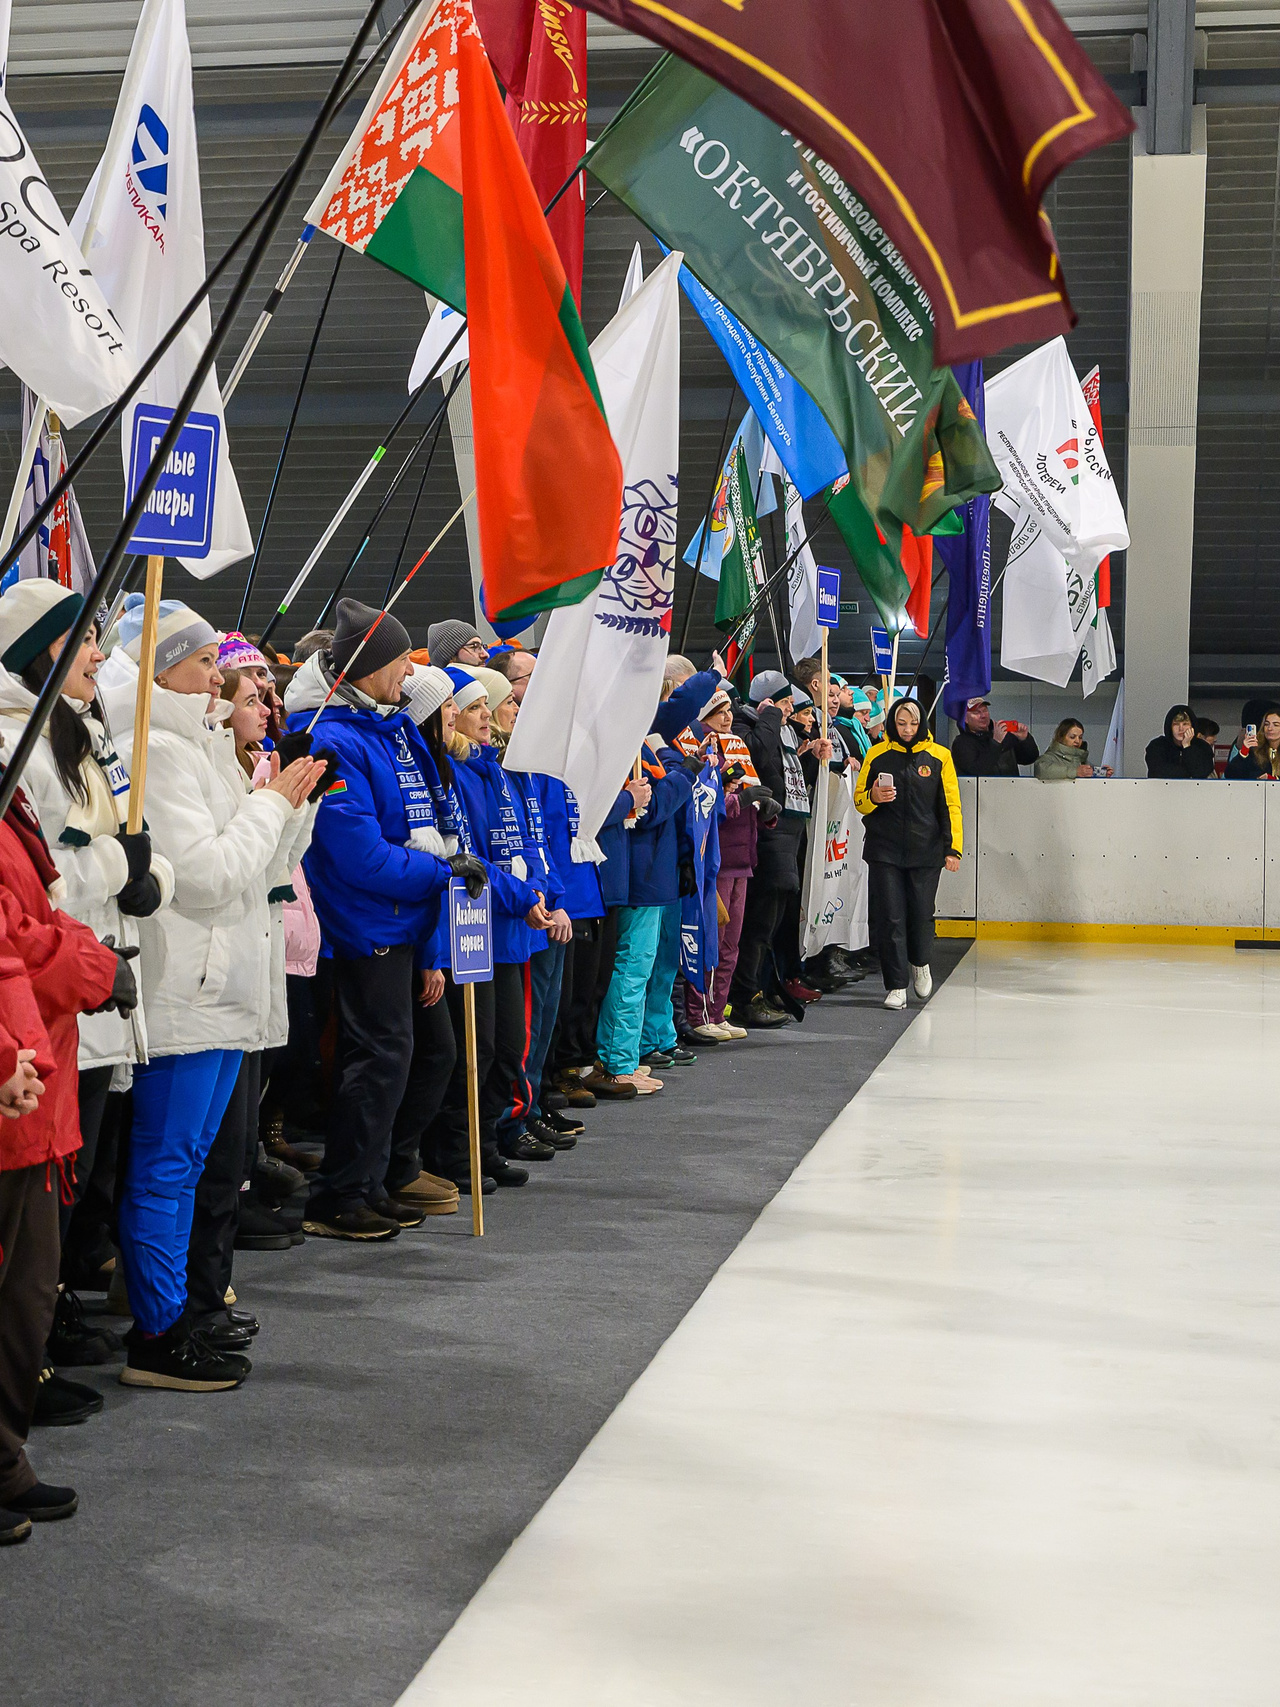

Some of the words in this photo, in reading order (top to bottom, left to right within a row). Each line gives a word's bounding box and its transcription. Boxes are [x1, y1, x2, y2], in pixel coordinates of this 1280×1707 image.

[786, 169, 804, 188] И
[797, 182, 880, 279] ГОСТИНИЧНЫЙ
[870, 274, 924, 342] КОМПЛЕКС
[42, 259, 124, 355] Resort
[713, 300, 747, 355] Президента
[743, 352, 770, 404] Республики
[767, 399, 792, 447] Беларусь
[752, 348, 783, 403] управление»
[1036, 452, 1067, 494] ЛОТЕРЕИ
